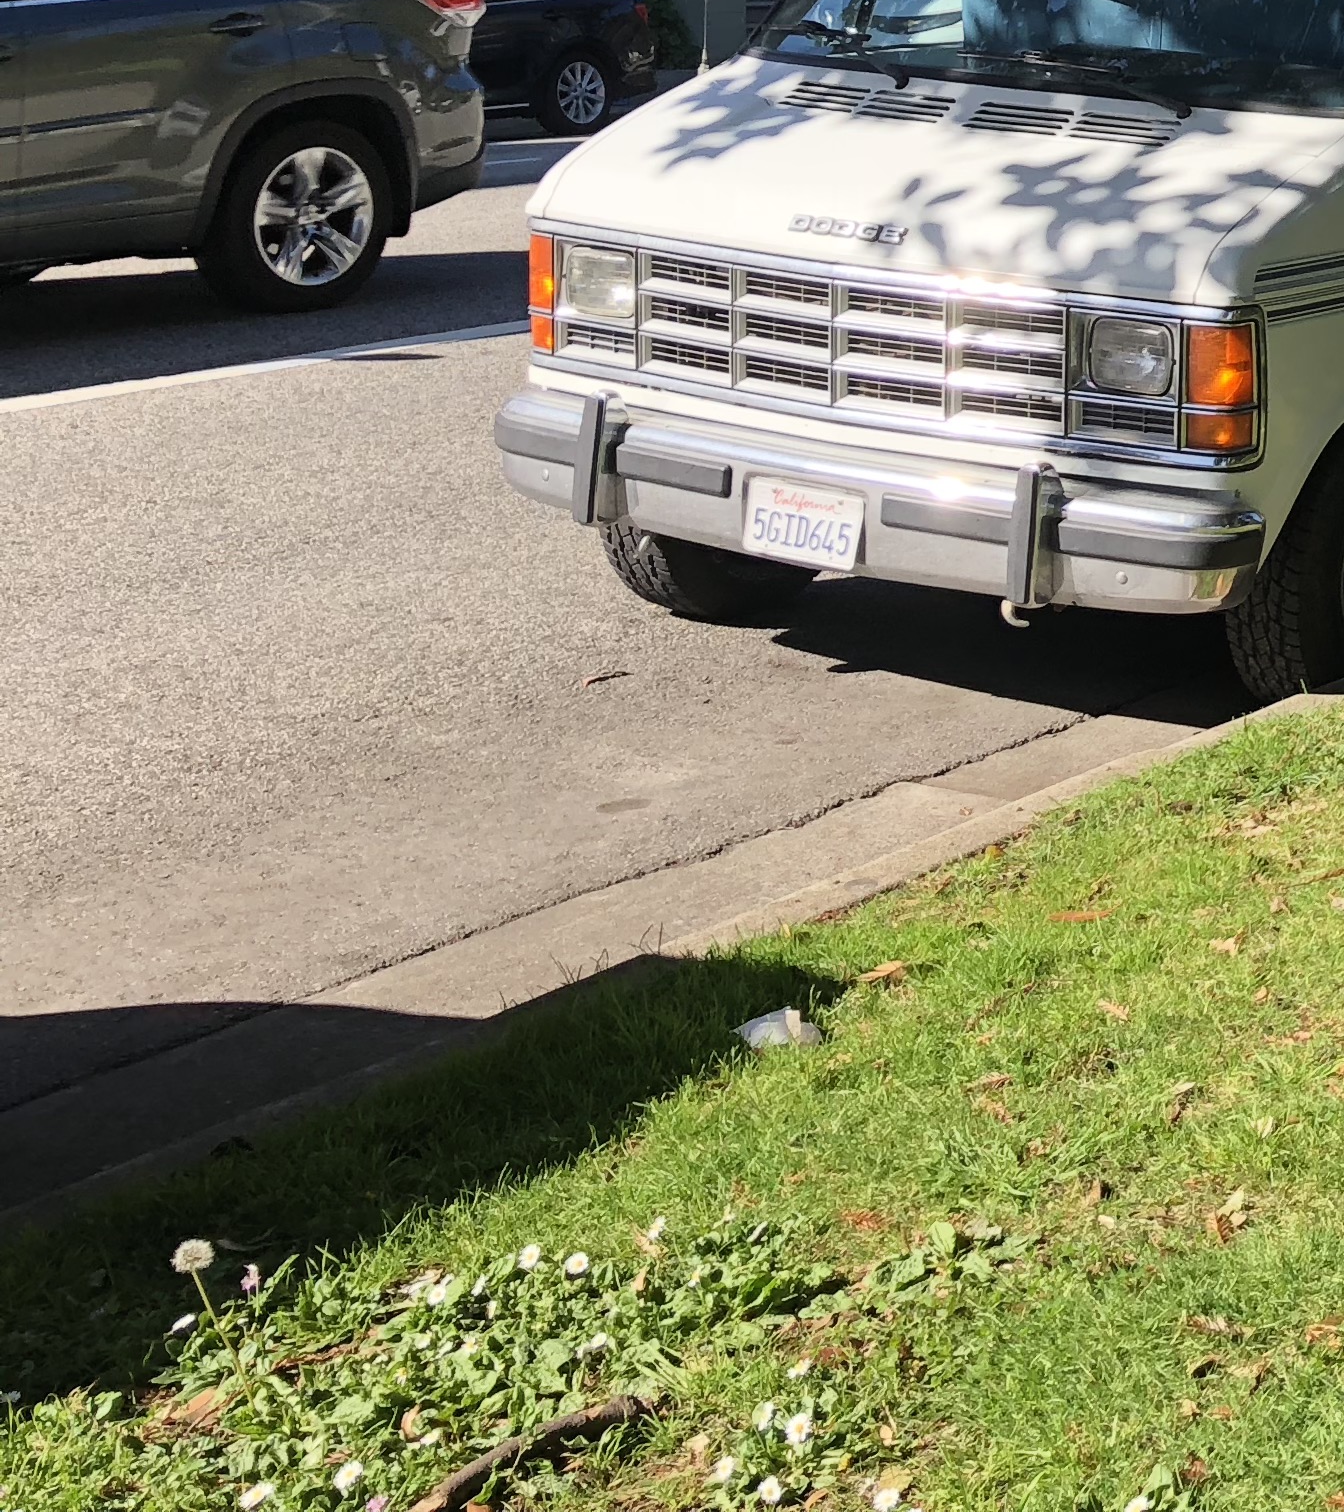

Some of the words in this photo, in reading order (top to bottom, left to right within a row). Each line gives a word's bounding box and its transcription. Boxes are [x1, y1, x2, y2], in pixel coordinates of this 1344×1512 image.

[788, 214, 909, 245] DODGE
[773, 489, 841, 514] California
[752, 507, 853, 557] 5GID645
